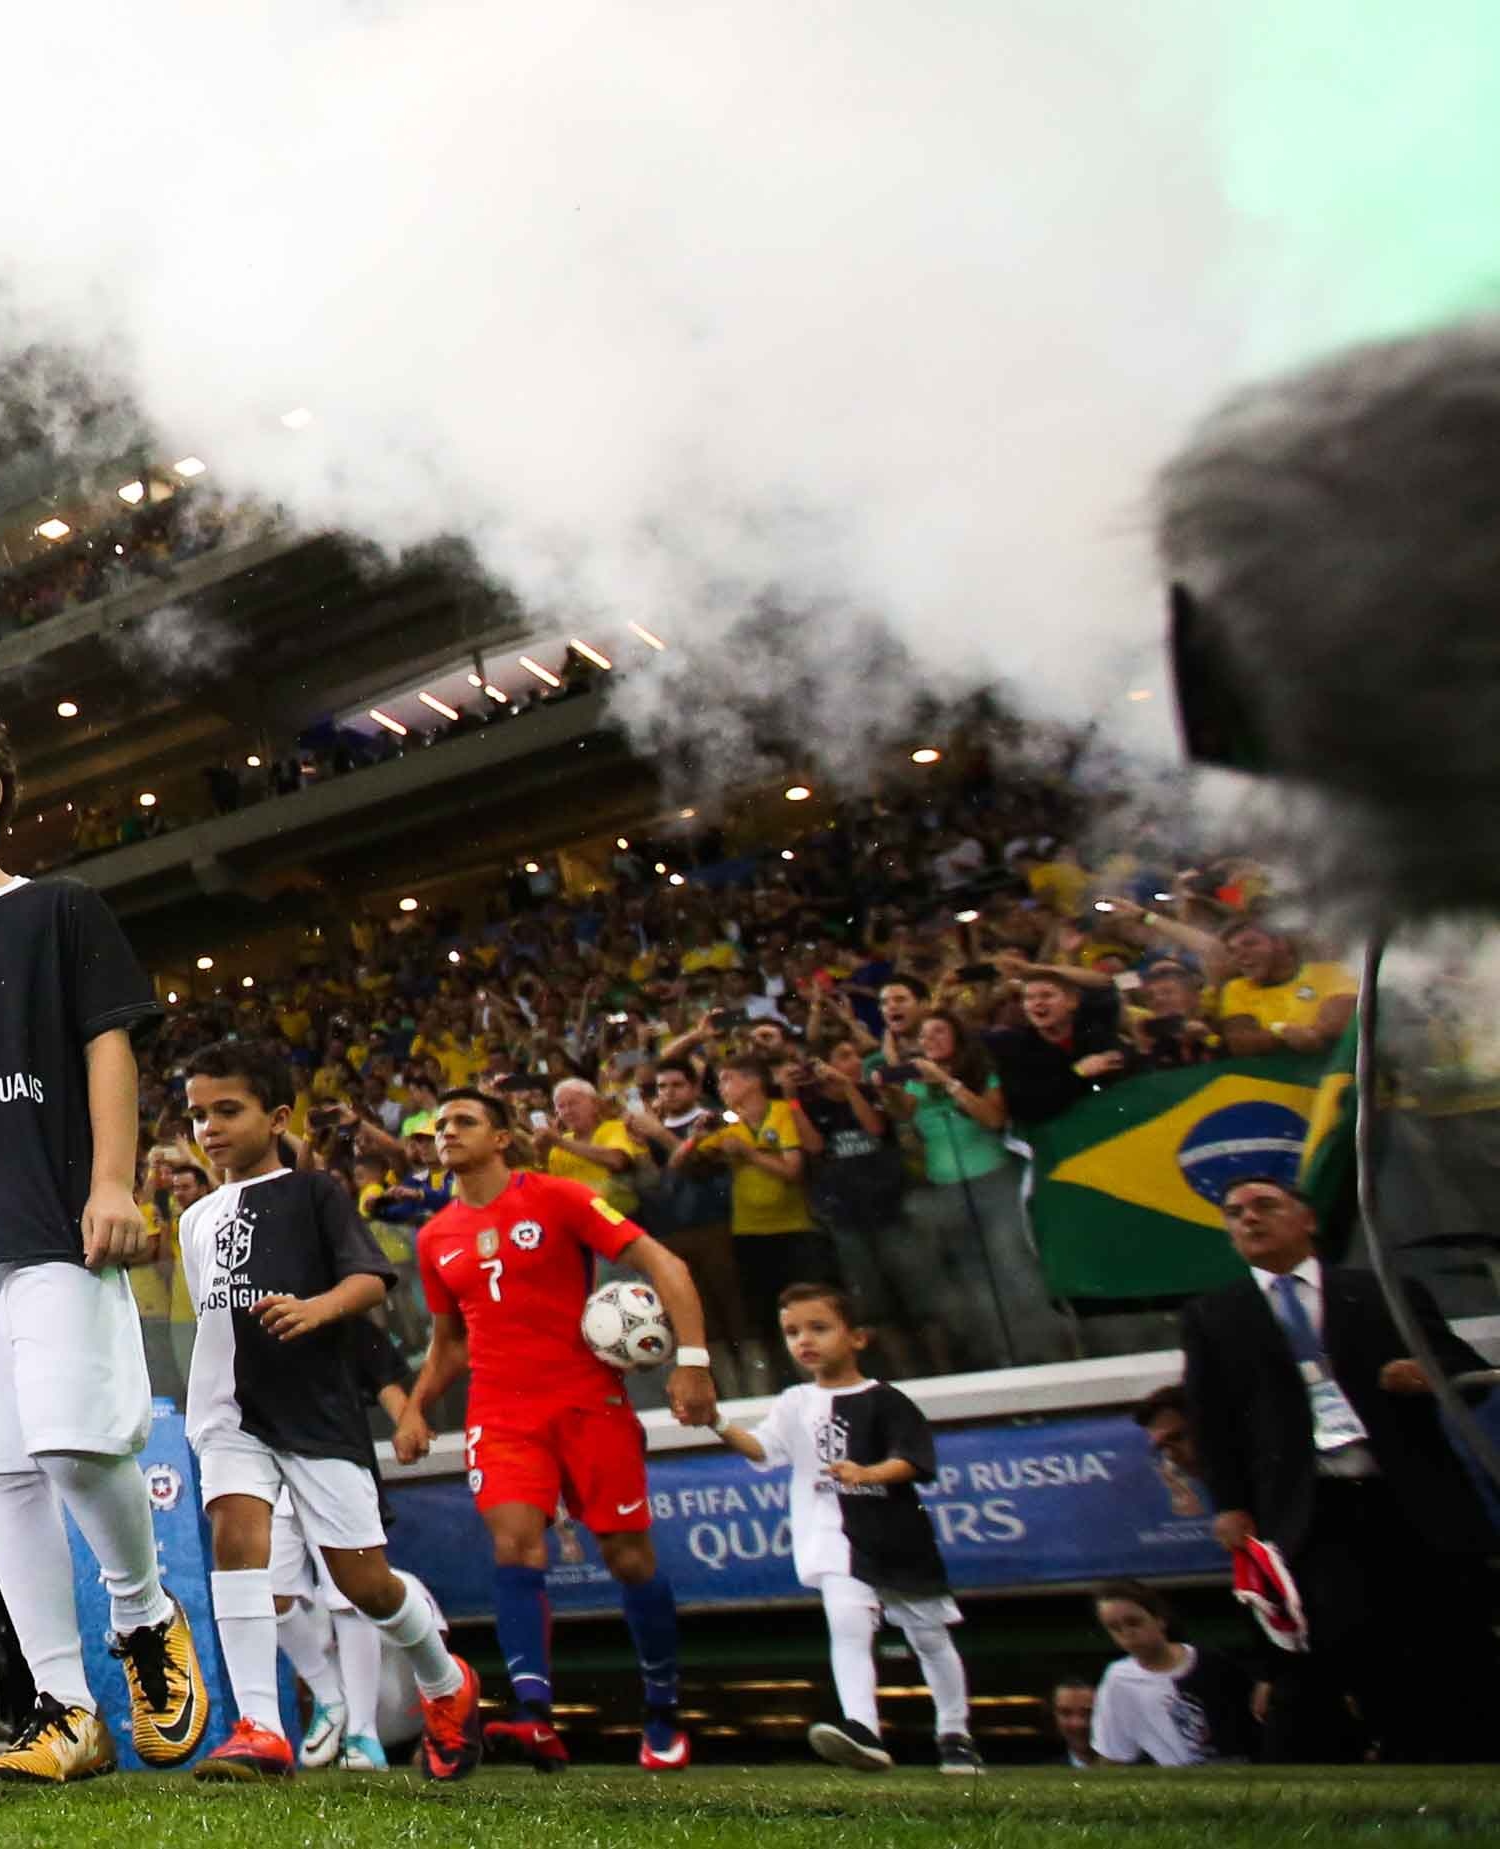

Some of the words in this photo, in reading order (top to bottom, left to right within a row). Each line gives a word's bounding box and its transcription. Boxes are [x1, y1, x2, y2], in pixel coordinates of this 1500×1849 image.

[213, 1273, 252, 1287] BRASIL
[480, 1258, 504, 1302] 7
[677, 1485, 749, 1519] FIFA
[968, 1452, 1113, 1493] RUSSIA
